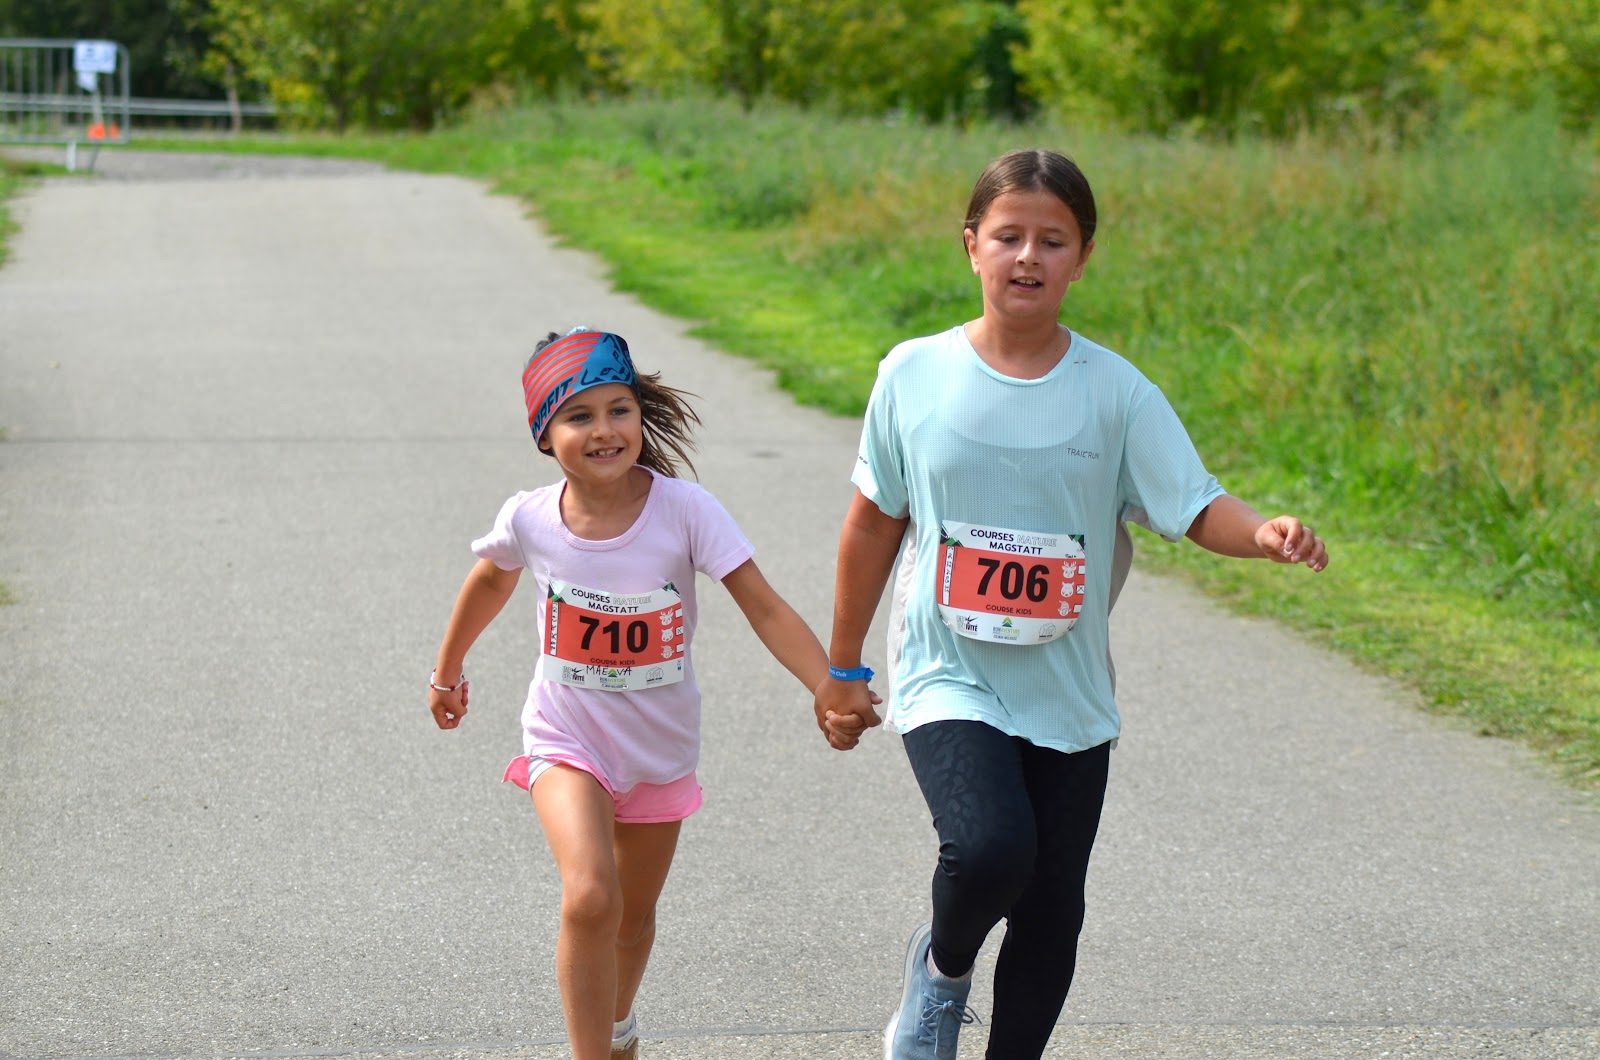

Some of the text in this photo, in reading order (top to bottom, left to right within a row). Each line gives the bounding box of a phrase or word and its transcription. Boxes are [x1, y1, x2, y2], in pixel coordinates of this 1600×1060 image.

[970, 528, 1058, 548] COURSES NATURE
[989, 541, 1043, 555] MAGSTATT
[976, 557, 1050, 603] 706
[571, 588, 652, 606] COURSES NATURE
[588, 601, 639, 614] MAGSTATT
[985, 604, 1033, 616] COURSE KIDS
[578, 615, 649, 654] 710
[589, 657, 636, 666] COURSE KIDS
